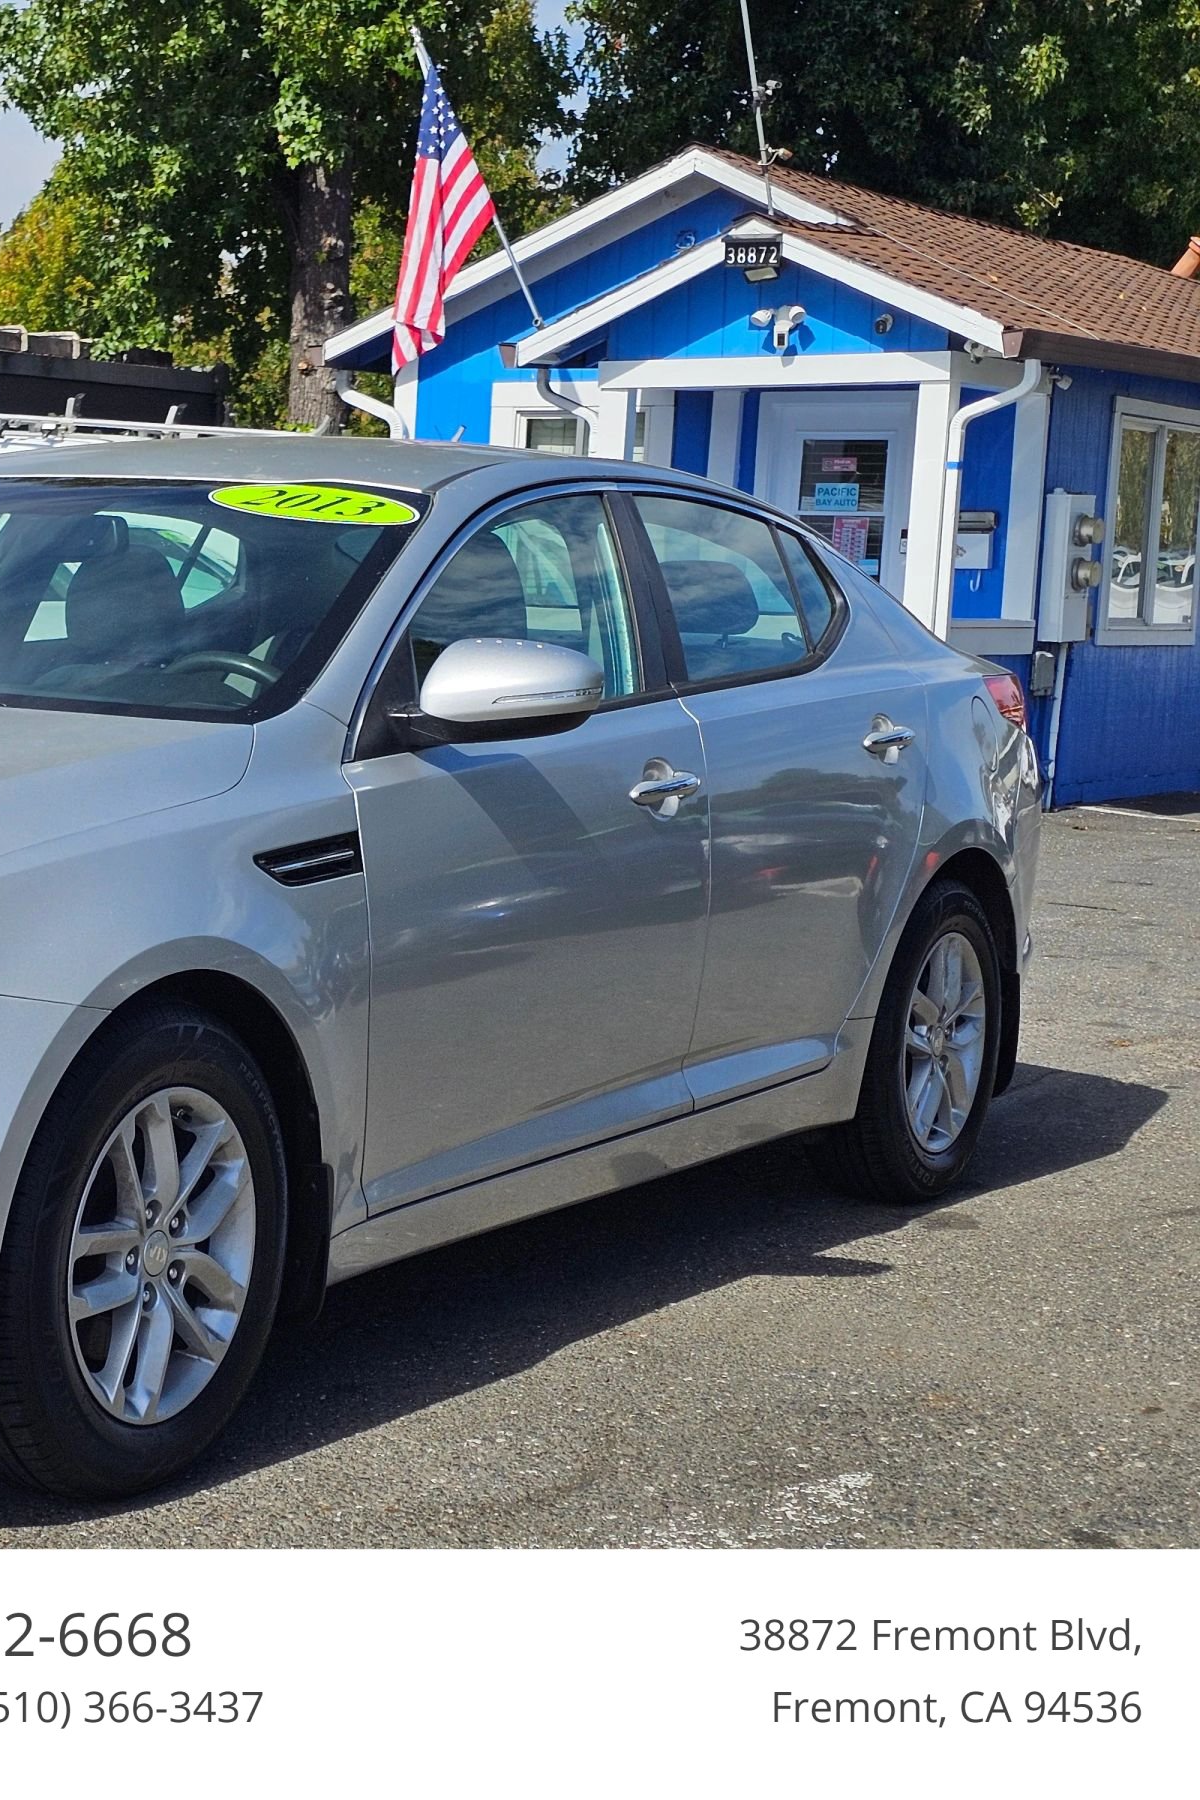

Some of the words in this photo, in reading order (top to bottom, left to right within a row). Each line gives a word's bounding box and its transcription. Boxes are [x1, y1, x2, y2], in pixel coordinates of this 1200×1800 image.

[726, 246, 778, 264] 38872
[817, 487, 857, 497] PACIFIC
[237, 489, 386, 517] 2013
[816, 498, 833, 507] BAY
[833, 498, 857, 507] AUTO
